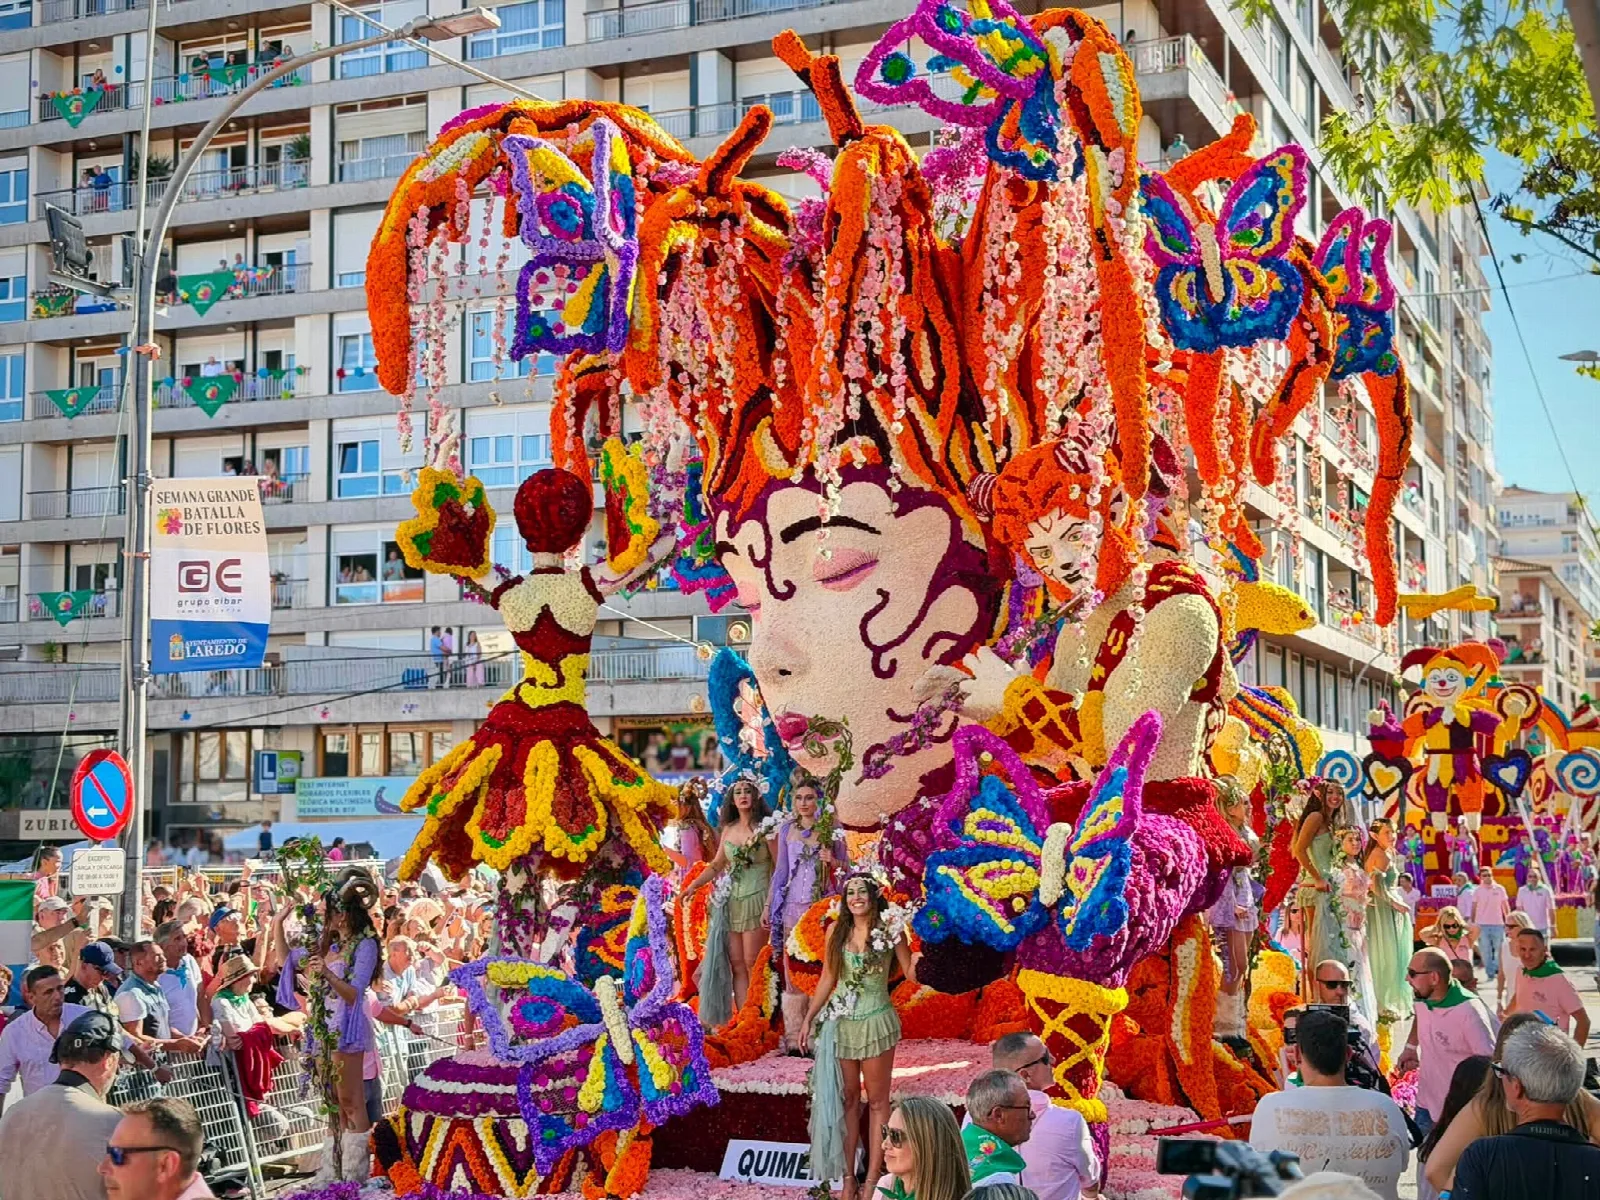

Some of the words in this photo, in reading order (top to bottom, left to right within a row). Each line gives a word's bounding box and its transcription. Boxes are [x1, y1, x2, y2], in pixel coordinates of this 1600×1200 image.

[156, 490, 205, 504] SEMANA
[206, 489, 256, 503] GRANDE
[184, 505, 246, 520] BATALLA
[184, 522, 203, 536] DE
[206, 521, 261, 535] FLORES
[177, 598, 210, 608] grupo
[214, 597, 242, 606] eibar
[185, 639, 237, 648] AYUNTAMIENTO
[186, 643, 246, 658] LAREDO
[336, 789, 371, 797] FLEXIBLES
[25, 819, 79, 831] ZURIC
[737, 1149, 838, 1181] QUIME
